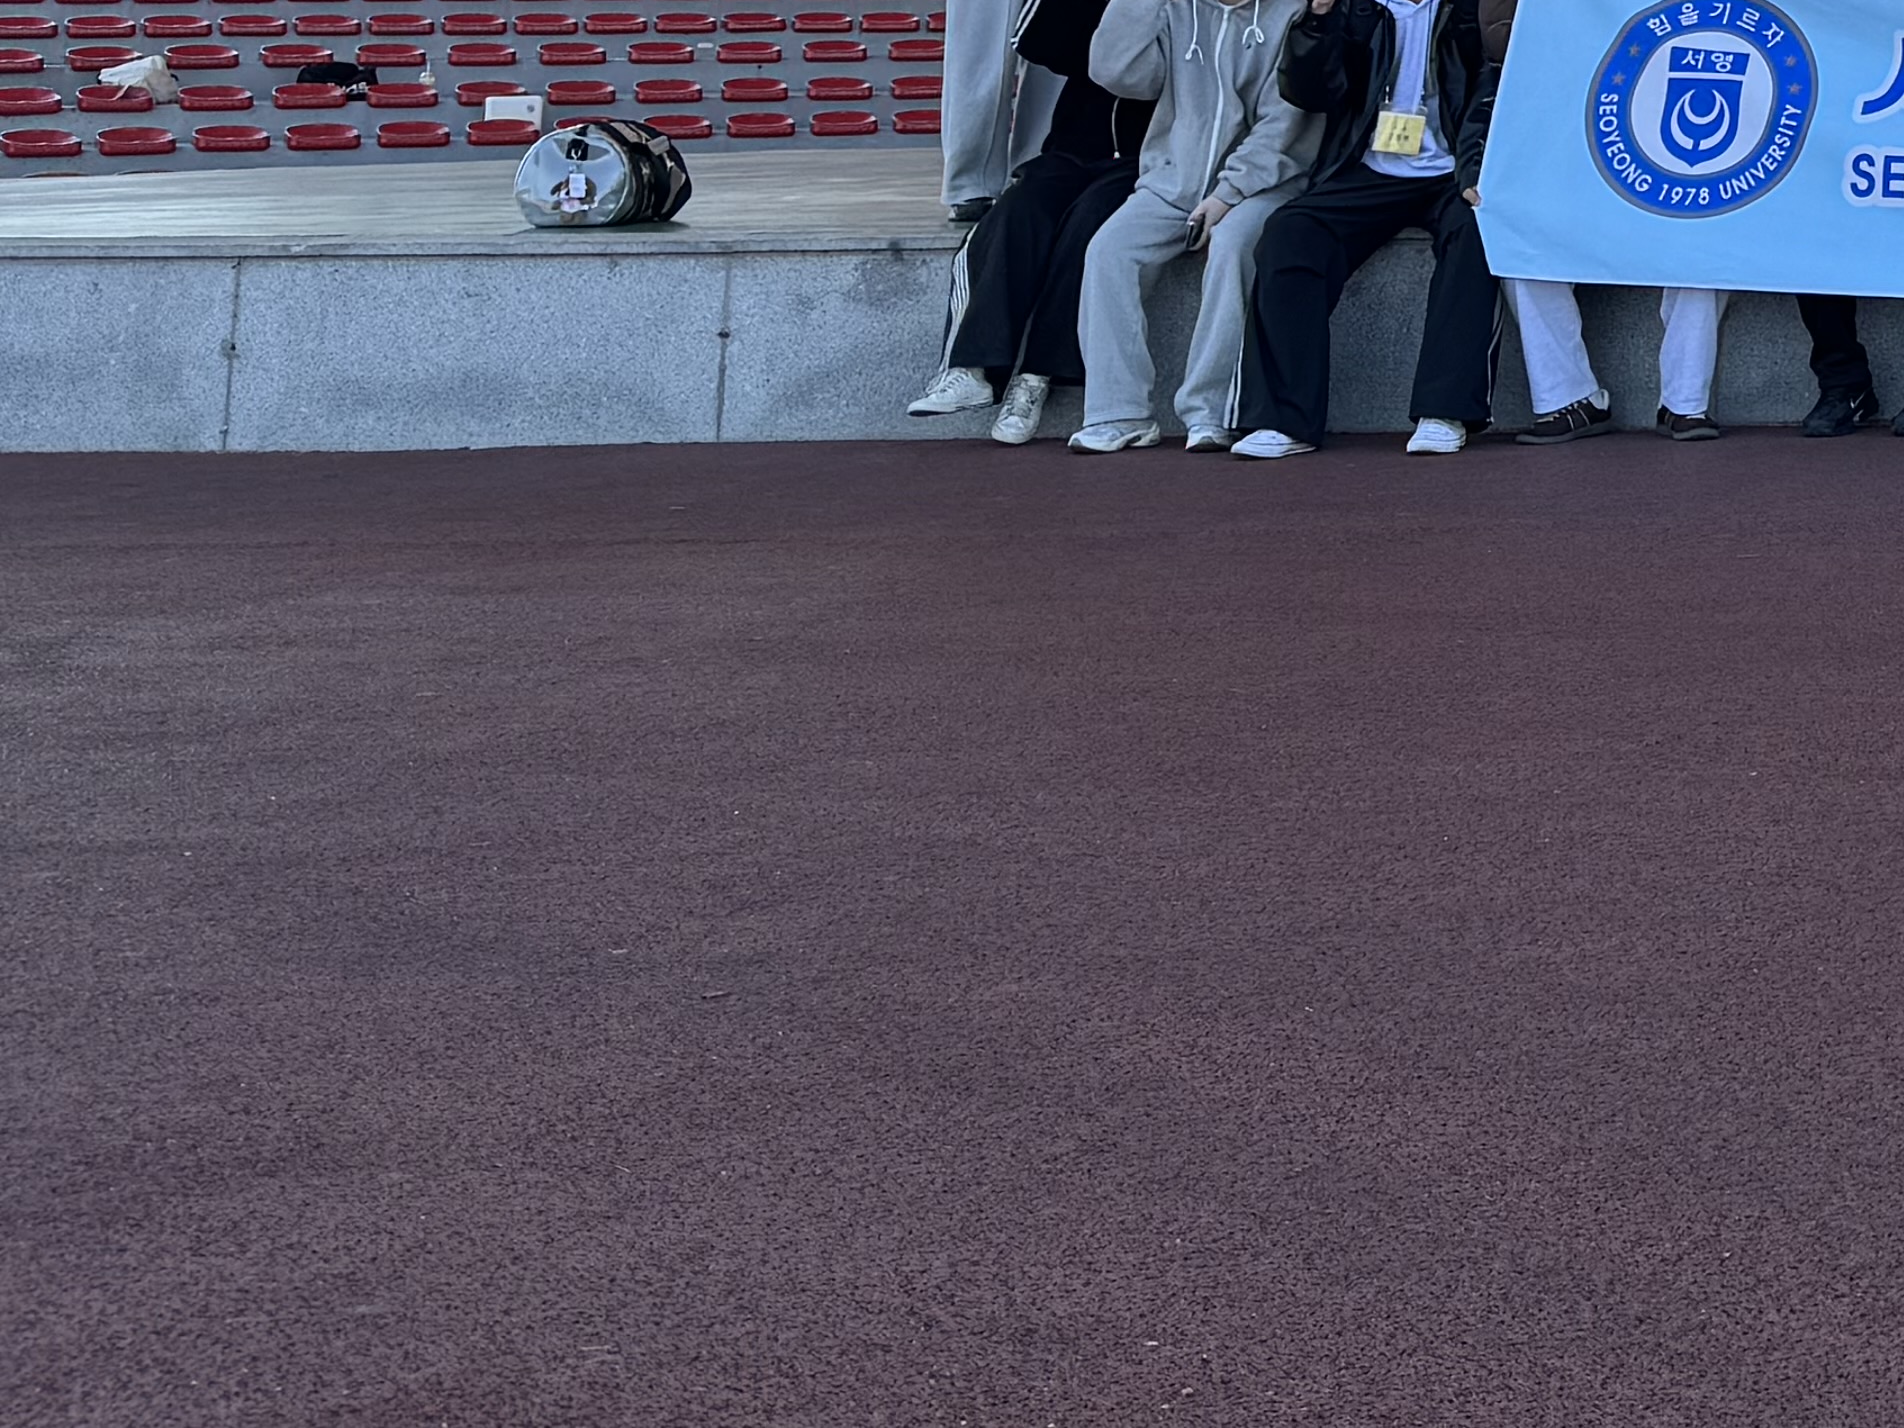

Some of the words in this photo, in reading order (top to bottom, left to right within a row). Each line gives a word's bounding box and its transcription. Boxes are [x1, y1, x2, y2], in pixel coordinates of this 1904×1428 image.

[1646, 3, 1700, 36] 힘을
[1708, 3, 1785, 48] 기르자
[1681, 50, 1734, 71] 서영
[1599, 93, 1652, 192] SEOYEONG
[1658, 184, 1710, 206] 1978
[1719, 104, 1802, 200] UNIVERSITY
